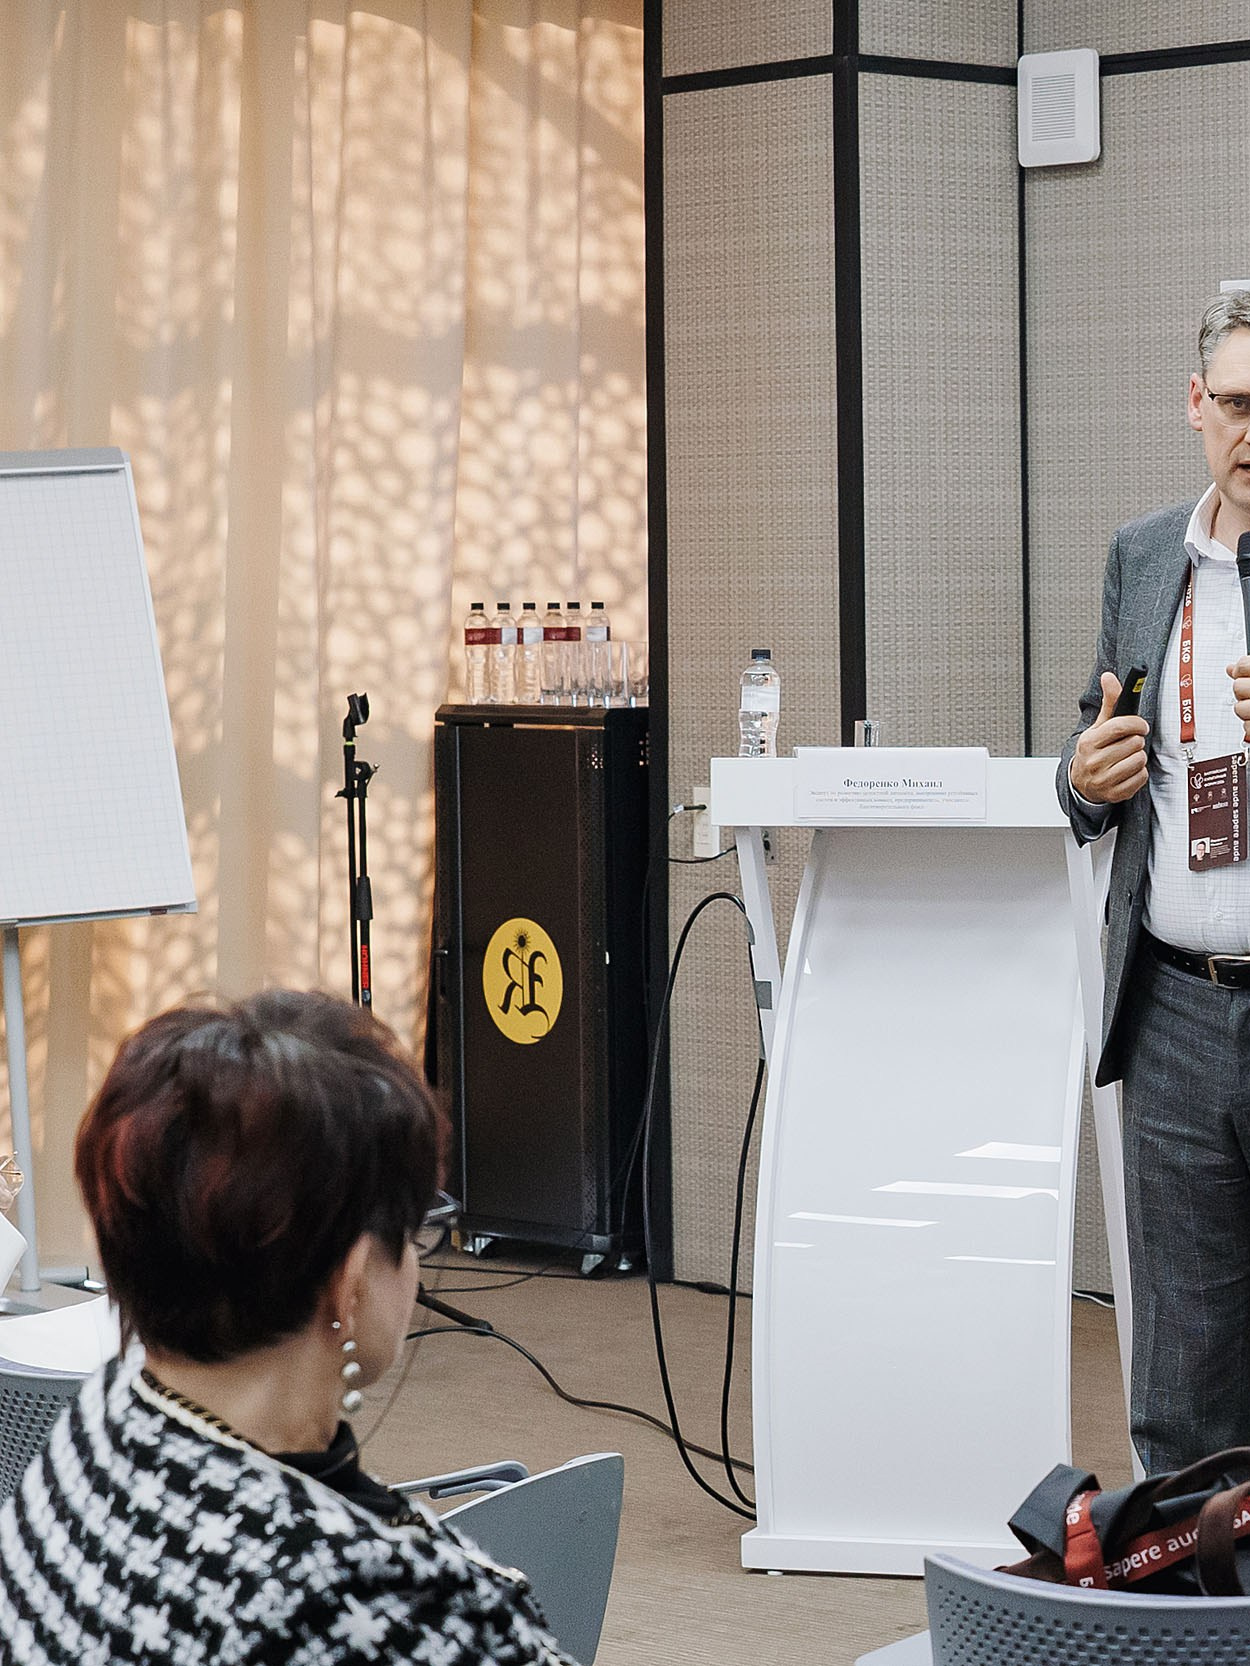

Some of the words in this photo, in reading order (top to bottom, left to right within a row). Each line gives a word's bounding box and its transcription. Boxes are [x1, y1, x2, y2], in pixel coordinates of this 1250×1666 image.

[1182, 640, 1191, 663] БКФ
[1182, 699, 1192, 723] БКФ
[843, 778, 899, 789] Федоренко
[902, 778, 943, 788] Михаил
[1105, 1546, 1162, 1580] sapere
